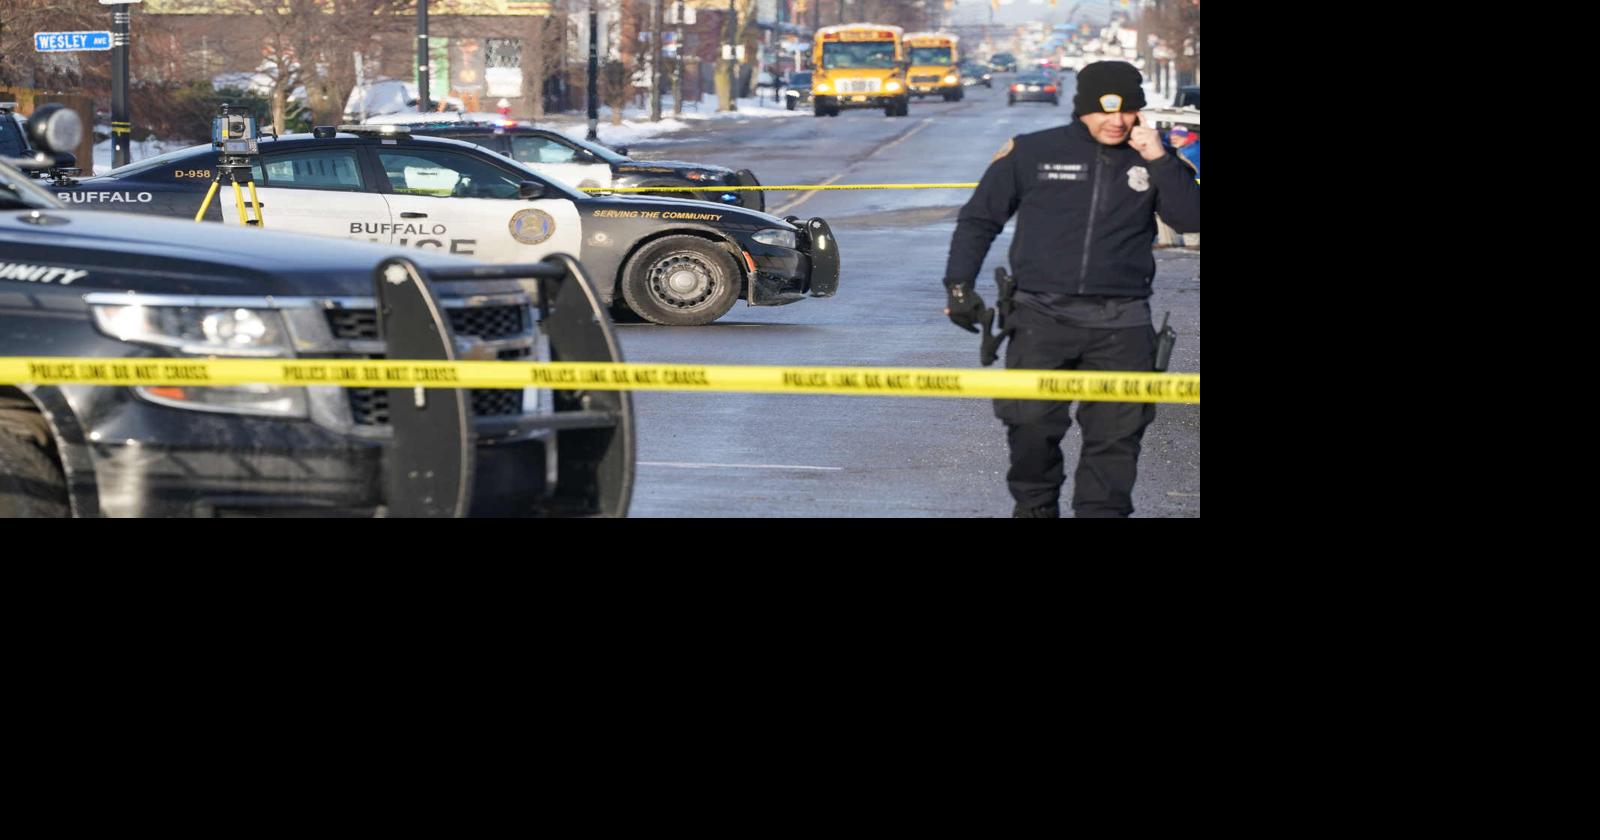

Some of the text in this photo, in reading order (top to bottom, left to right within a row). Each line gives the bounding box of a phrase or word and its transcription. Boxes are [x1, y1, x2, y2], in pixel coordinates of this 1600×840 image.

[38, 35, 107, 49] WESLEY AVE
[174, 170, 211, 178] D-958
[57, 191, 153, 203] BUFFALO
[593, 209, 723, 221] SERVING THE COMMUNITY
[349, 222, 447, 236] BUFFALO
[30, 364, 209, 380] POLICE LINE DO NOT CROSS
[283, 366, 459, 381] POLICE LINE DO NOT CROSS
[531, 368, 709, 385] POLICE LINE DO NOT CROSS
[783, 372, 962, 390] POLICE LINE DO NOT CROSS
[1039, 377, 1084, 393] POLICE
[1089, 378, 1115, 395] LINE
[1122, 379, 1139, 396] DO
[1147, 380, 1171, 396] NOT
